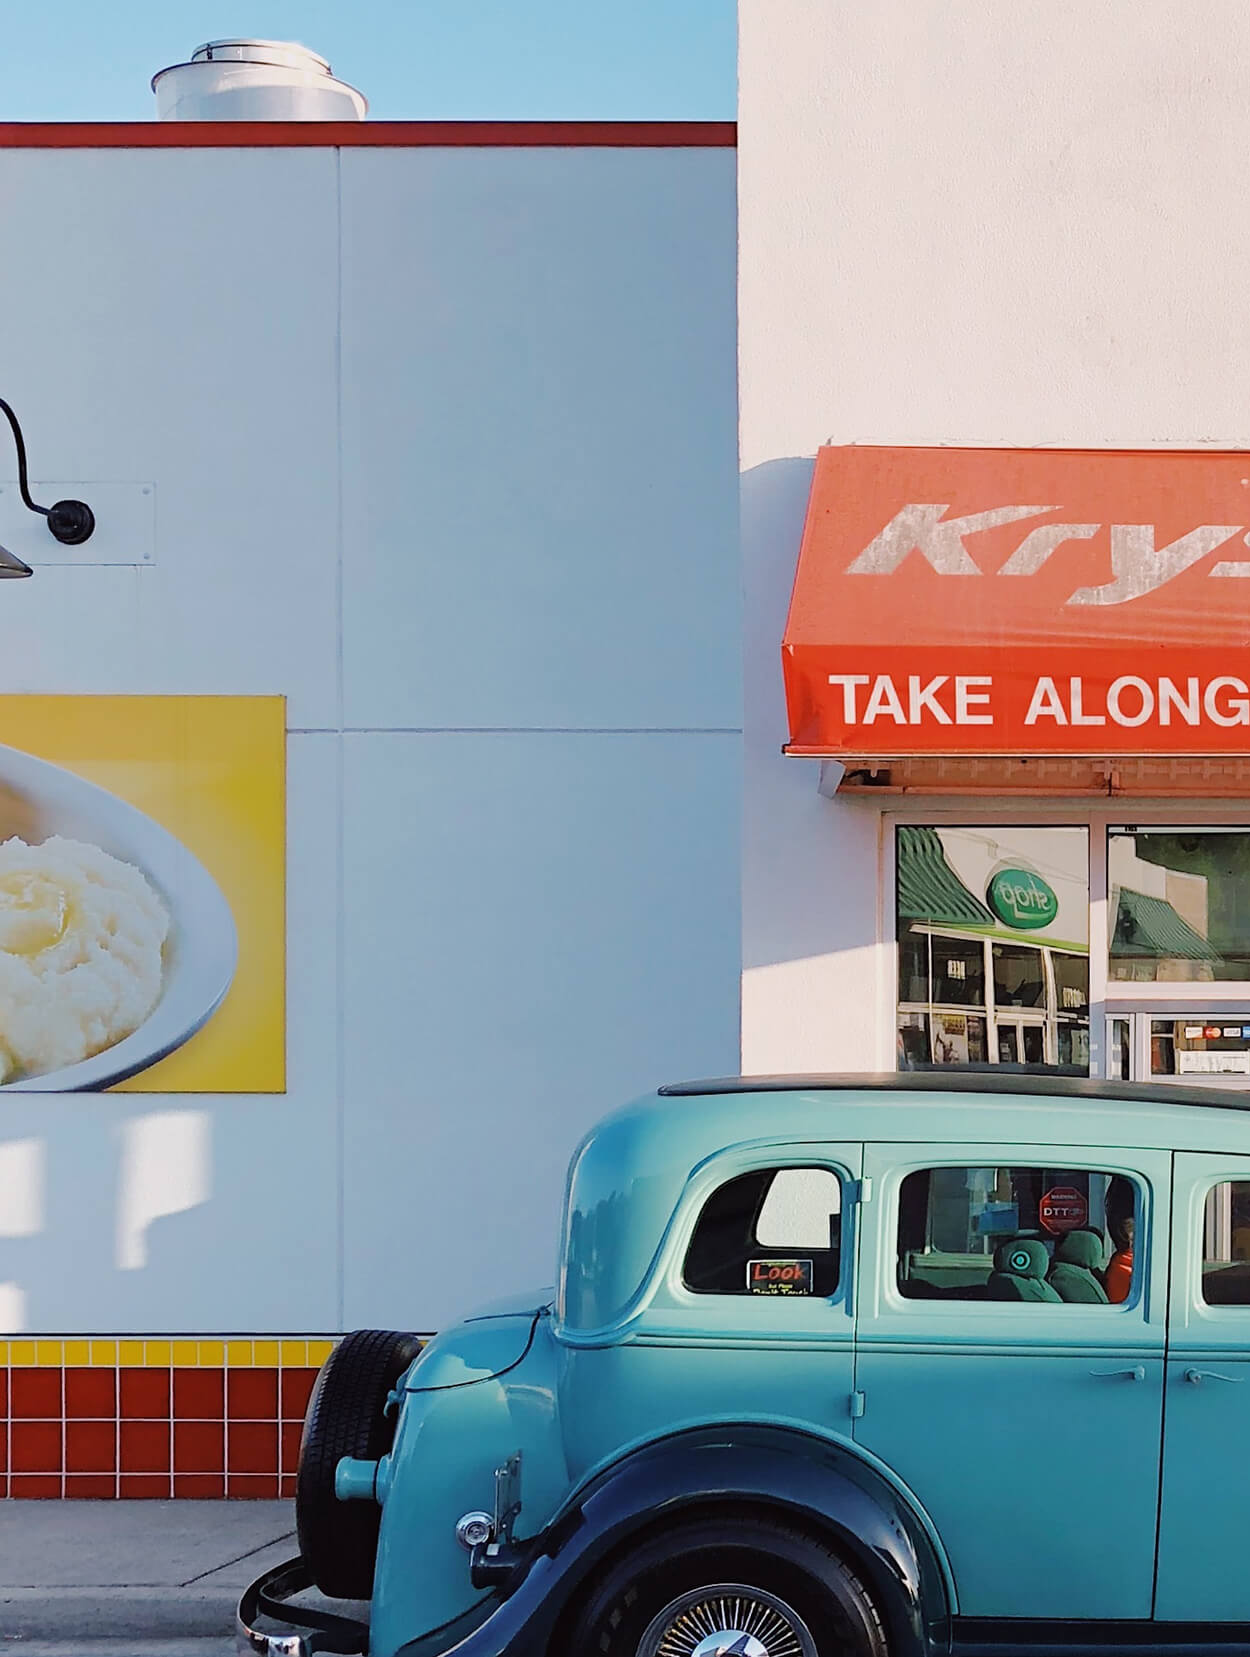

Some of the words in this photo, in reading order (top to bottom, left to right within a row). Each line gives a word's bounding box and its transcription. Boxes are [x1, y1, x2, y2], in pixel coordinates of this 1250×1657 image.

[829, 675, 993, 725] TAKE
[1024, 676, 1250, 726] ALONG
[752, 1263, 805, 1280] Look
